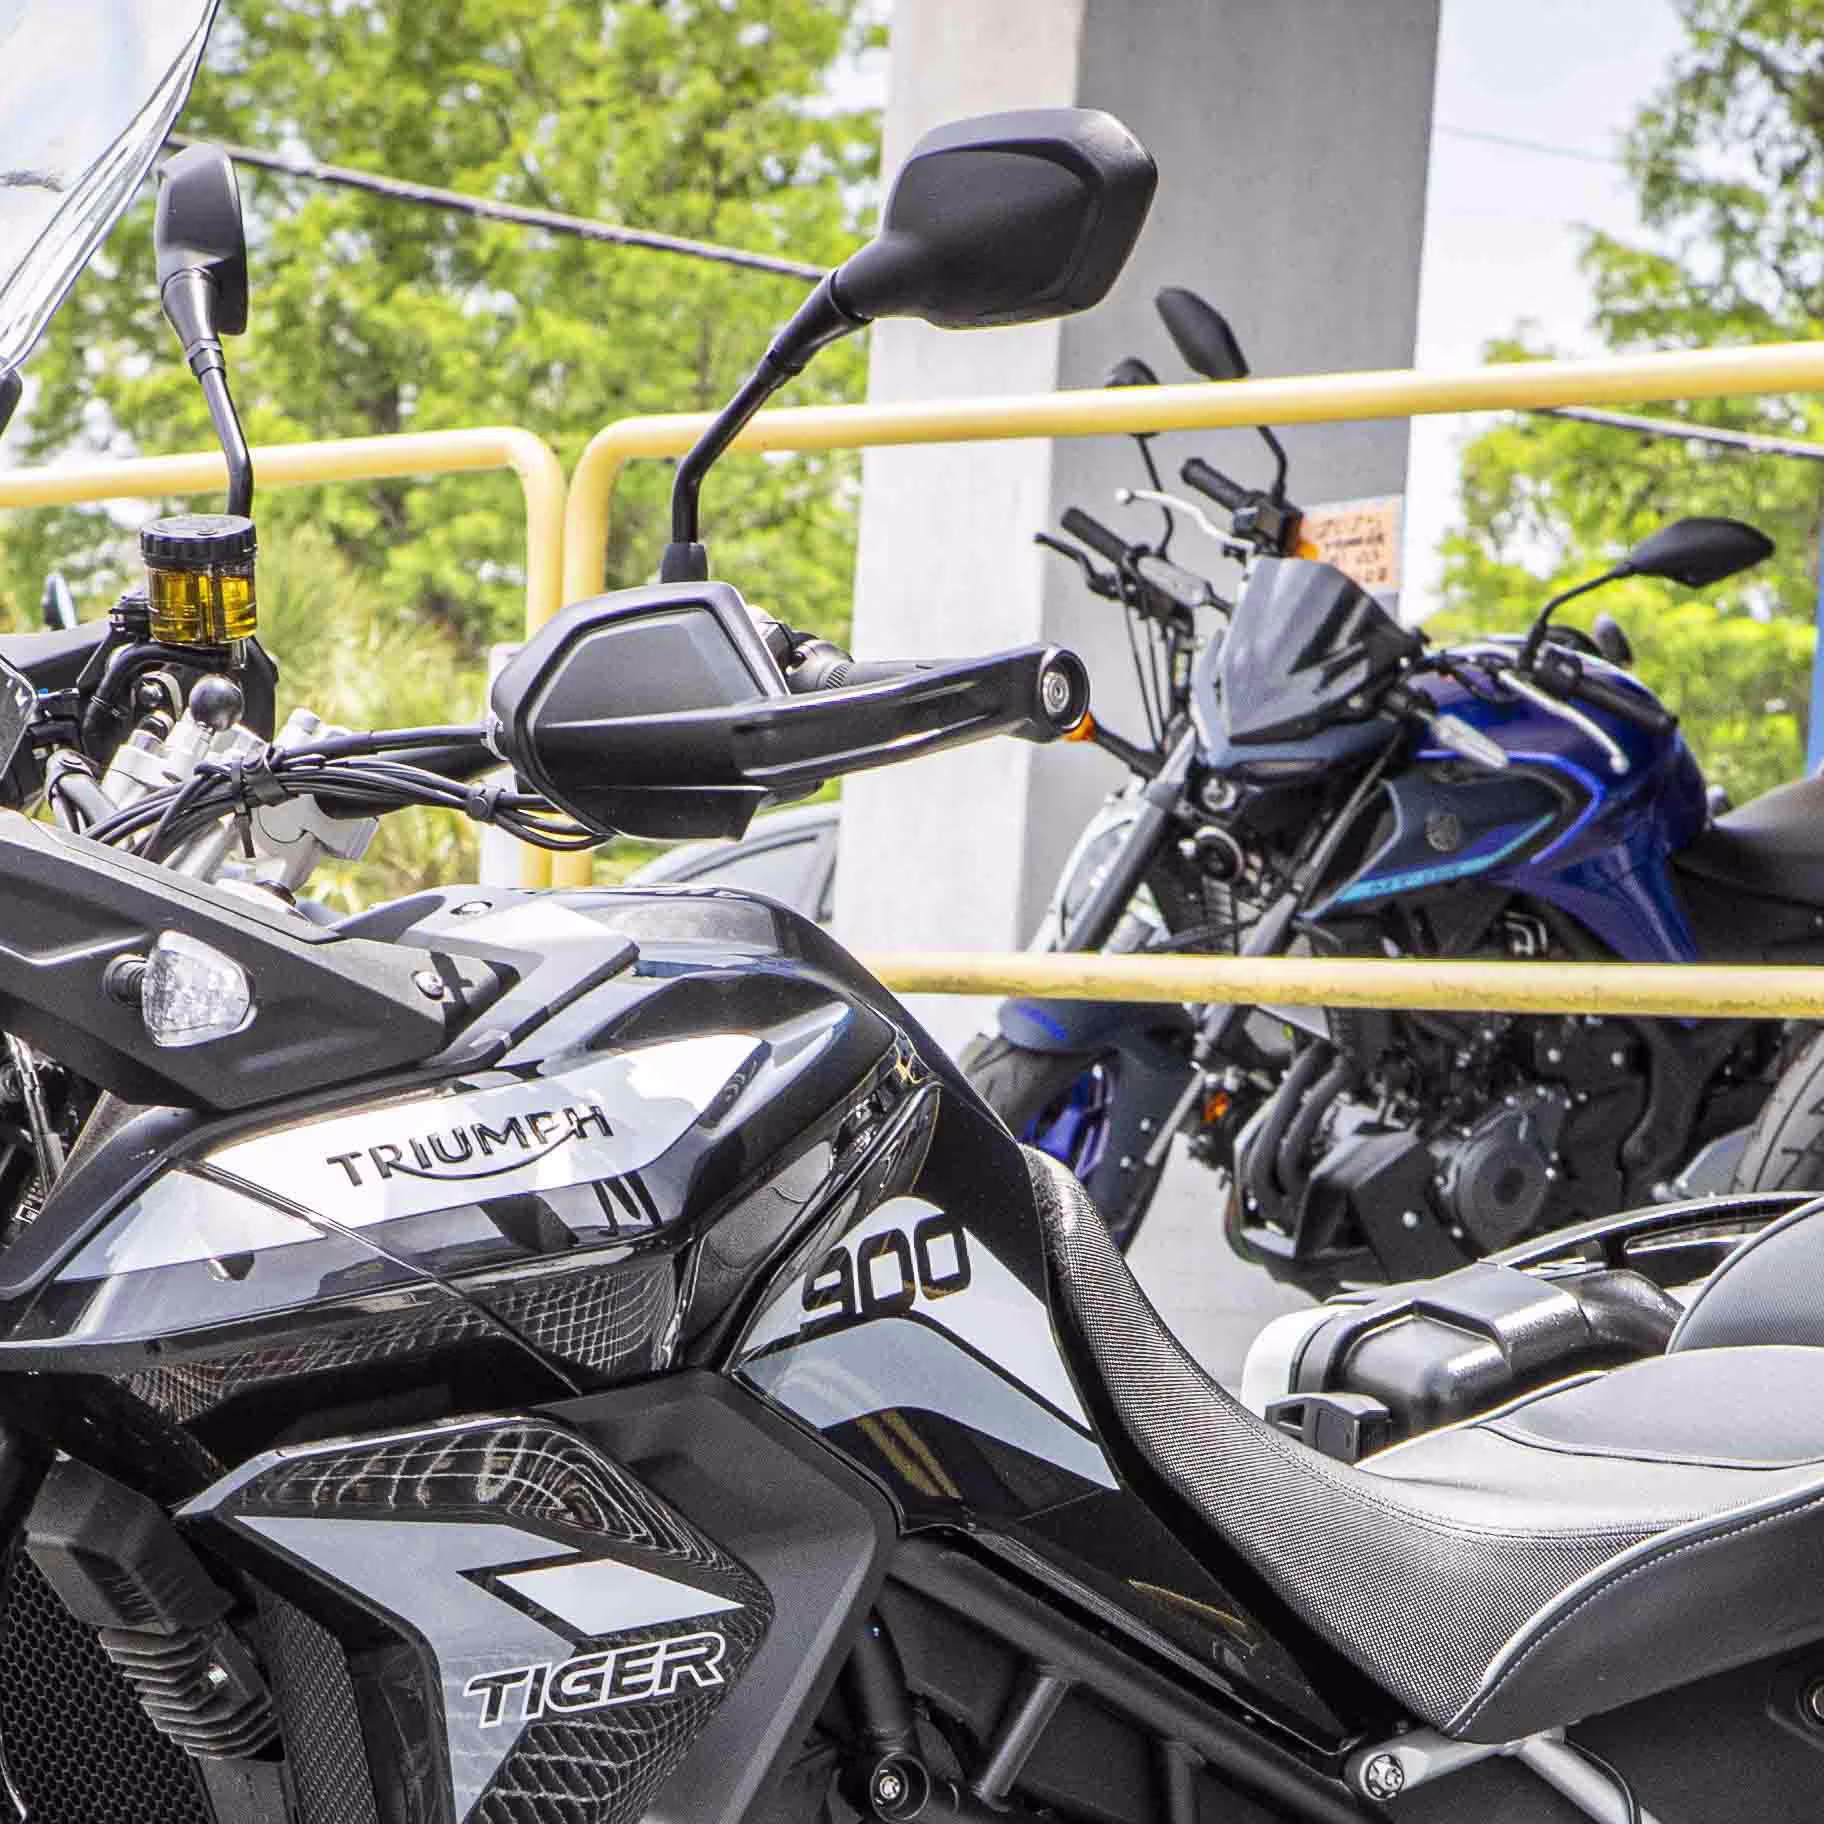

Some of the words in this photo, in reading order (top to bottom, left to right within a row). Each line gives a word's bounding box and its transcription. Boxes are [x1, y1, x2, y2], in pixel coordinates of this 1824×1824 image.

[326, 1104, 614, 1188] TRIUMPH
[801, 1213, 971, 1321] 900
[463, 1631, 726, 1729] TIGER
